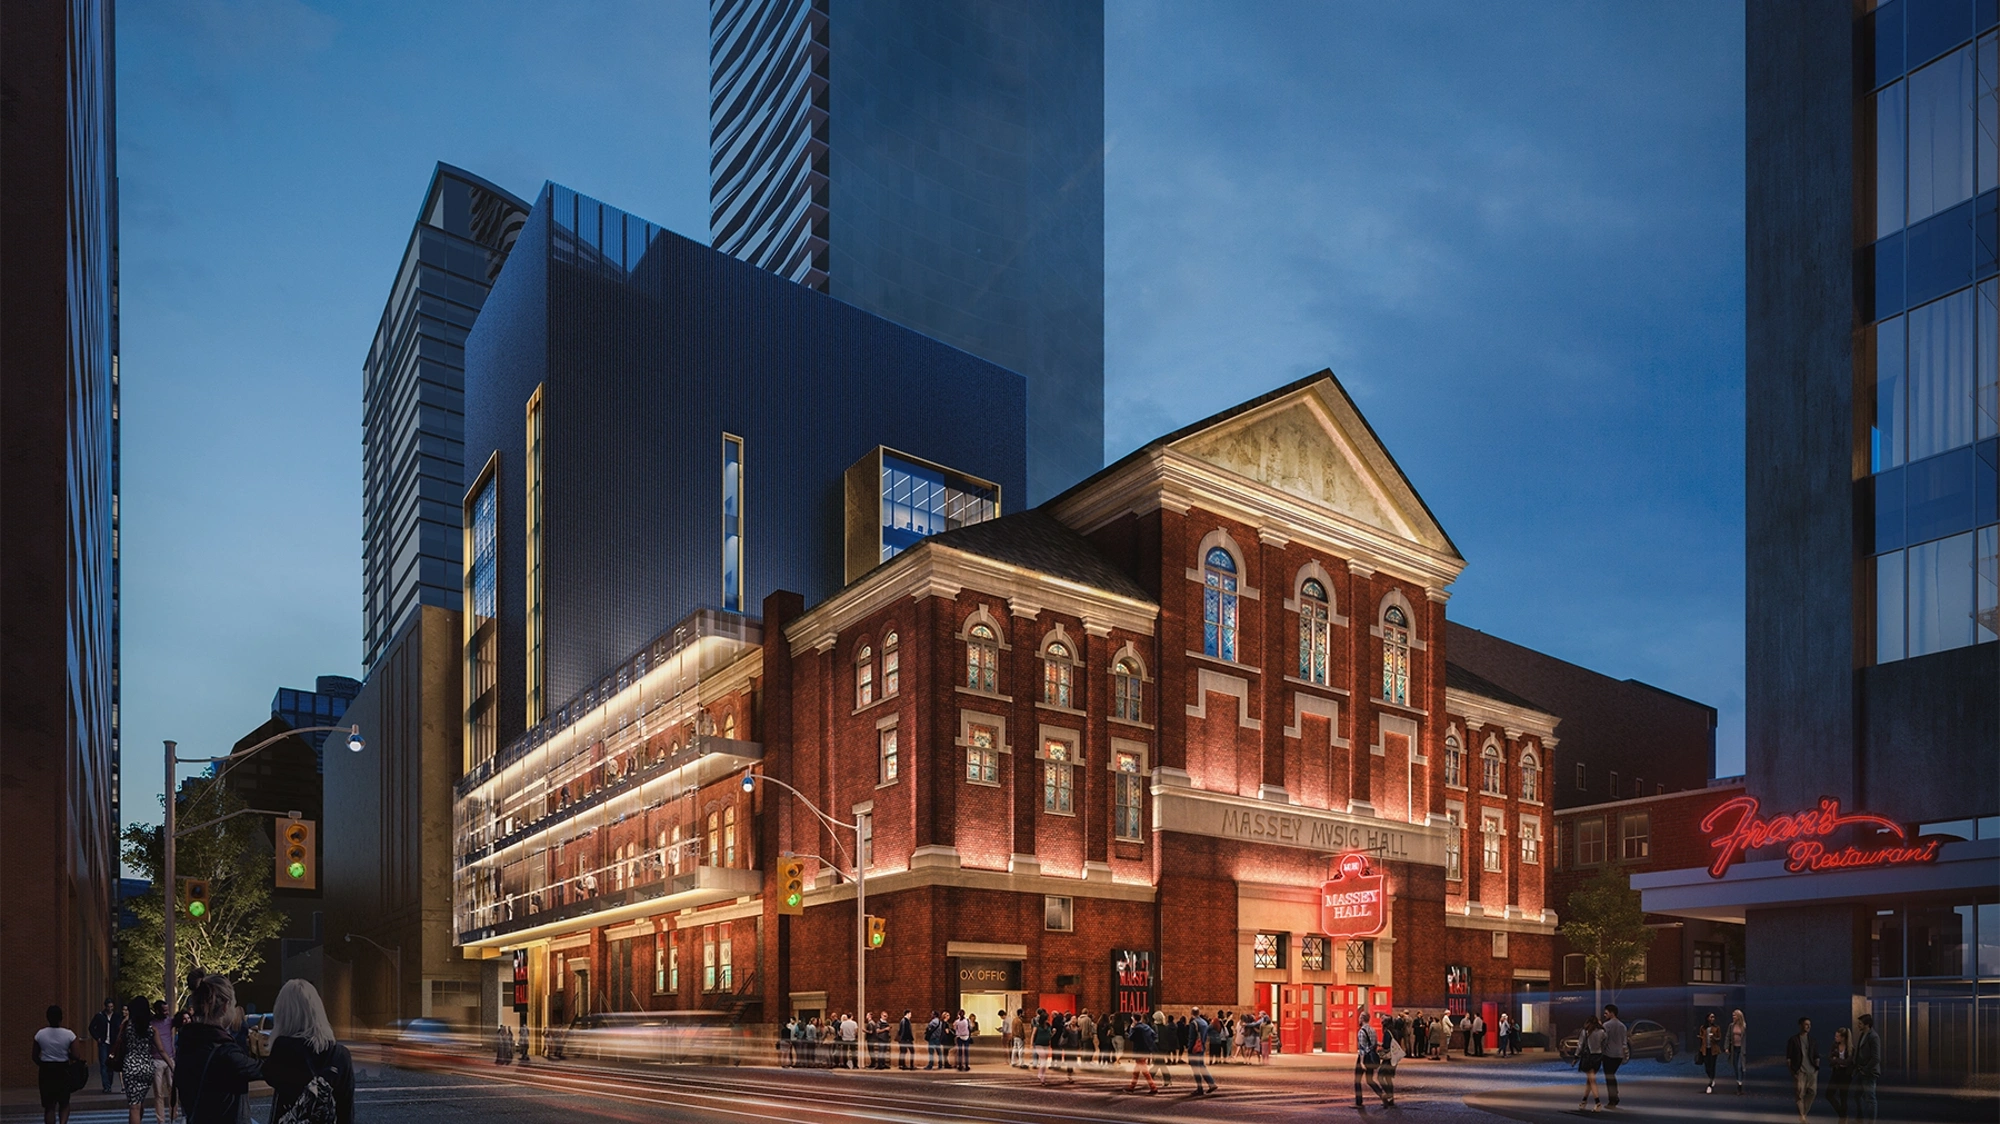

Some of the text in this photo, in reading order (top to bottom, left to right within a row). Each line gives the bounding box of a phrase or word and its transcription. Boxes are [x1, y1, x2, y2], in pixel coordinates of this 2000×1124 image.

[1222, 808, 1302, 841] MASSEY
[1367, 829, 1408, 856] HALL
[1700, 796, 1904, 876] Fran's
[1788, 840, 1939, 872] Restaurant
[1325, 889, 1380, 907] MASSEY
[1333, 904, 1371, 919] HALL
[1119, 991, 1150, 1014] HALL
